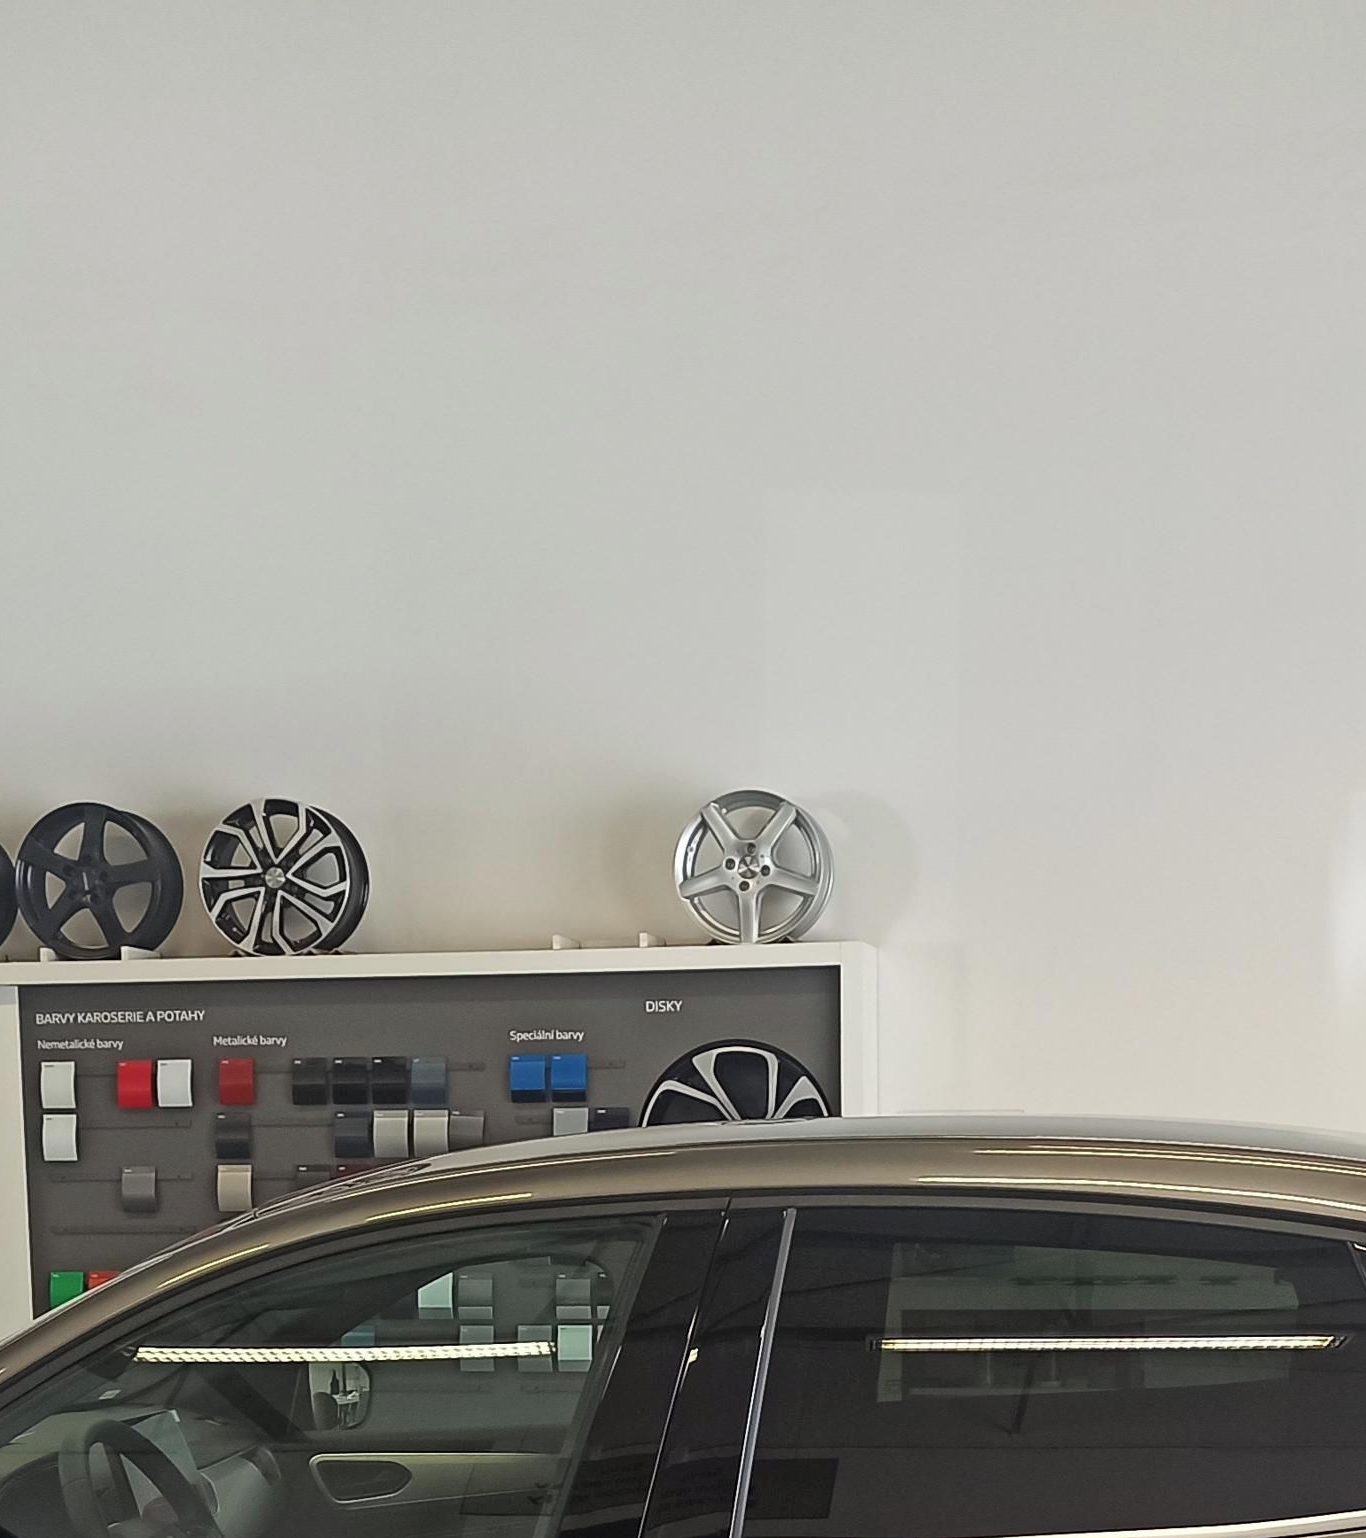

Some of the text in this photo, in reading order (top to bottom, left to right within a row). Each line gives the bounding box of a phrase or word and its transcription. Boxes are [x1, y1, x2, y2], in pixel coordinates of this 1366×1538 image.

[645, 1000, 683, 1013] DISKY
[35, 1010, 206, 1025] BARVY KAROSERIE A POTAHY
[213, 1035, 287, 1047] Metalické barvy
[509, 1030, 584, 1043] Speciální barvy
[37, 1039, 124, 1051] Nemetalické barvy
